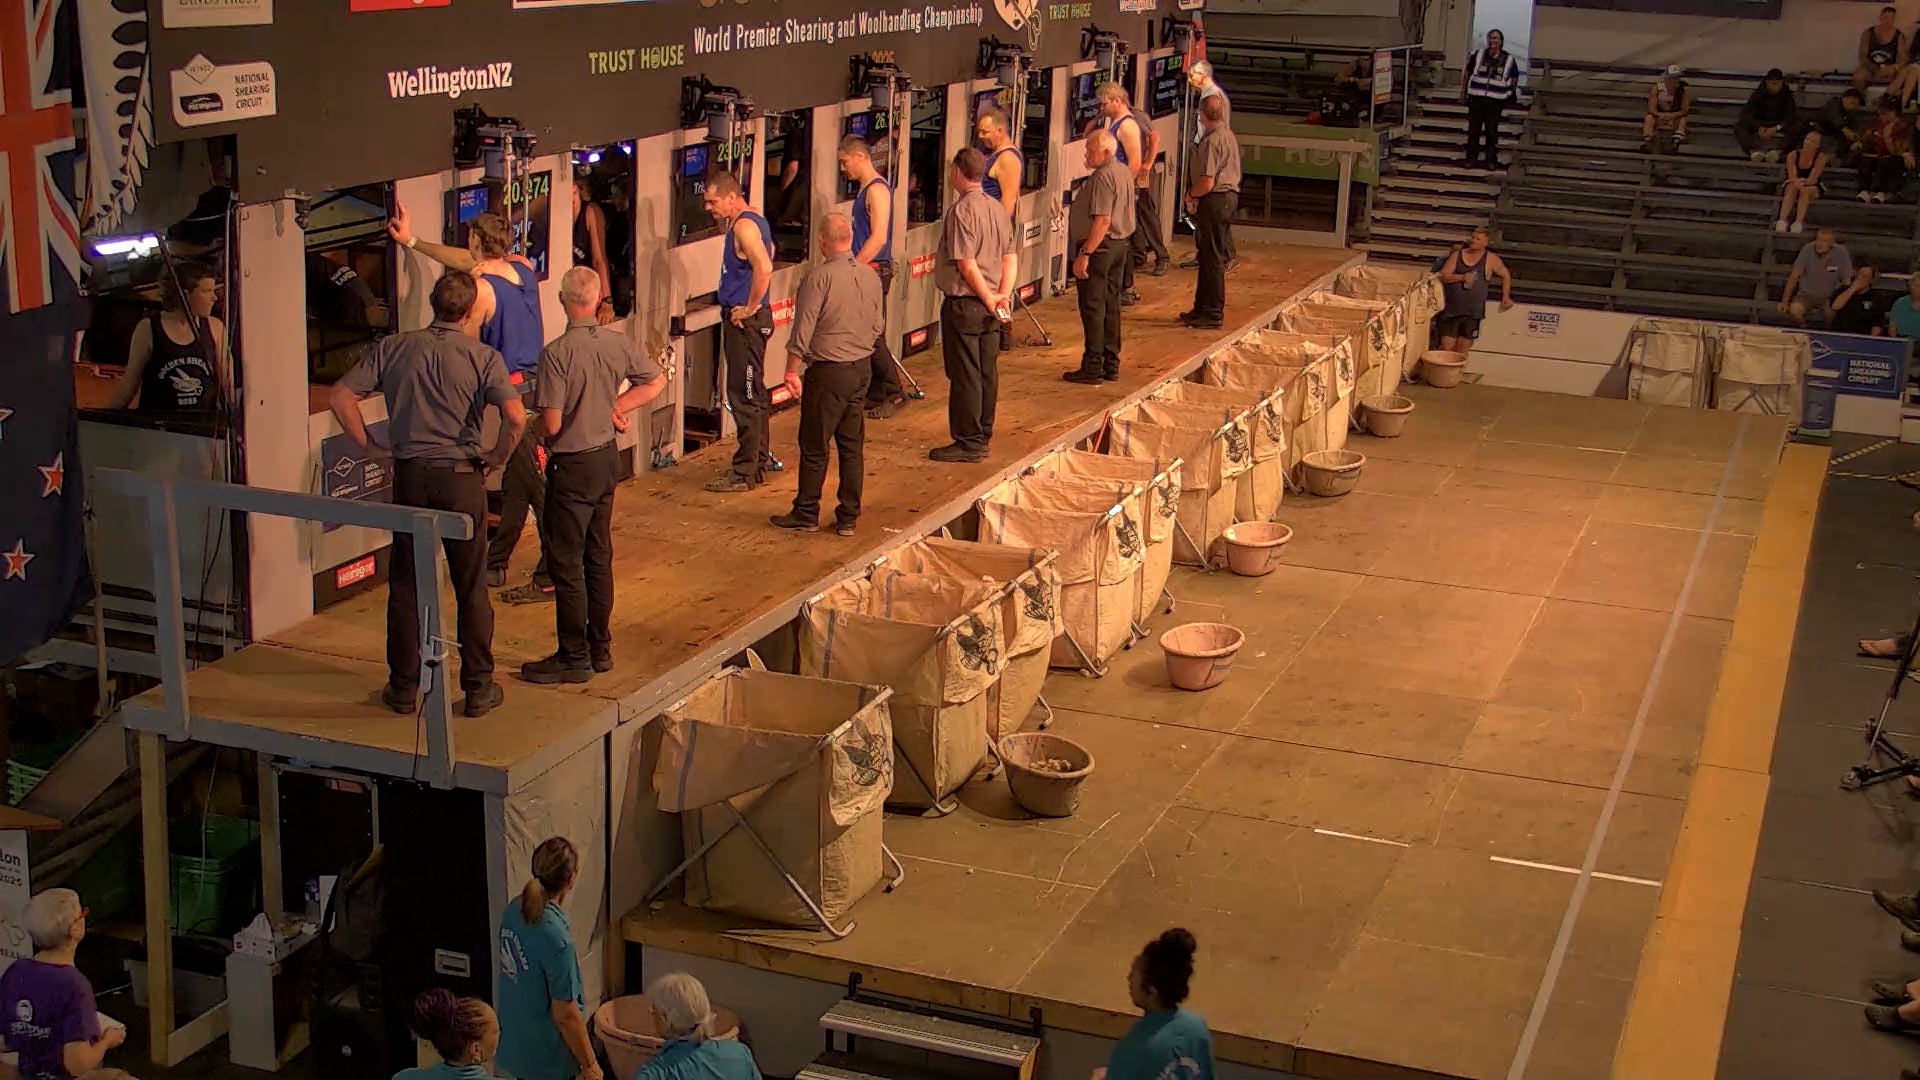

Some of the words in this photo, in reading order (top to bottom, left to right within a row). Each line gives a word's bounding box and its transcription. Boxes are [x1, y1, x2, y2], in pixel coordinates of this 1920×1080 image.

[1048, 5, 1069, 19] TRUST
[694, 24, 731, 54] World
[736, 22, 781, 49] Premier
[785, 17, 834, 44] Shearing
[837, 12, 856, 38] and
[858, 8, 921, 34] Woolhandling
[924, 3, 983, 31] Championship
[588, 48, 636, 75] TRUST
[640, 44, 685, 70] HOUSE
[234, 73, 270, 84] NATIONAL
[387, 62, 513, 99] WellingtonNZ
[234, 84, 271, 97] SHEARING
[234, 97, 263, 109] CIRCUIT
